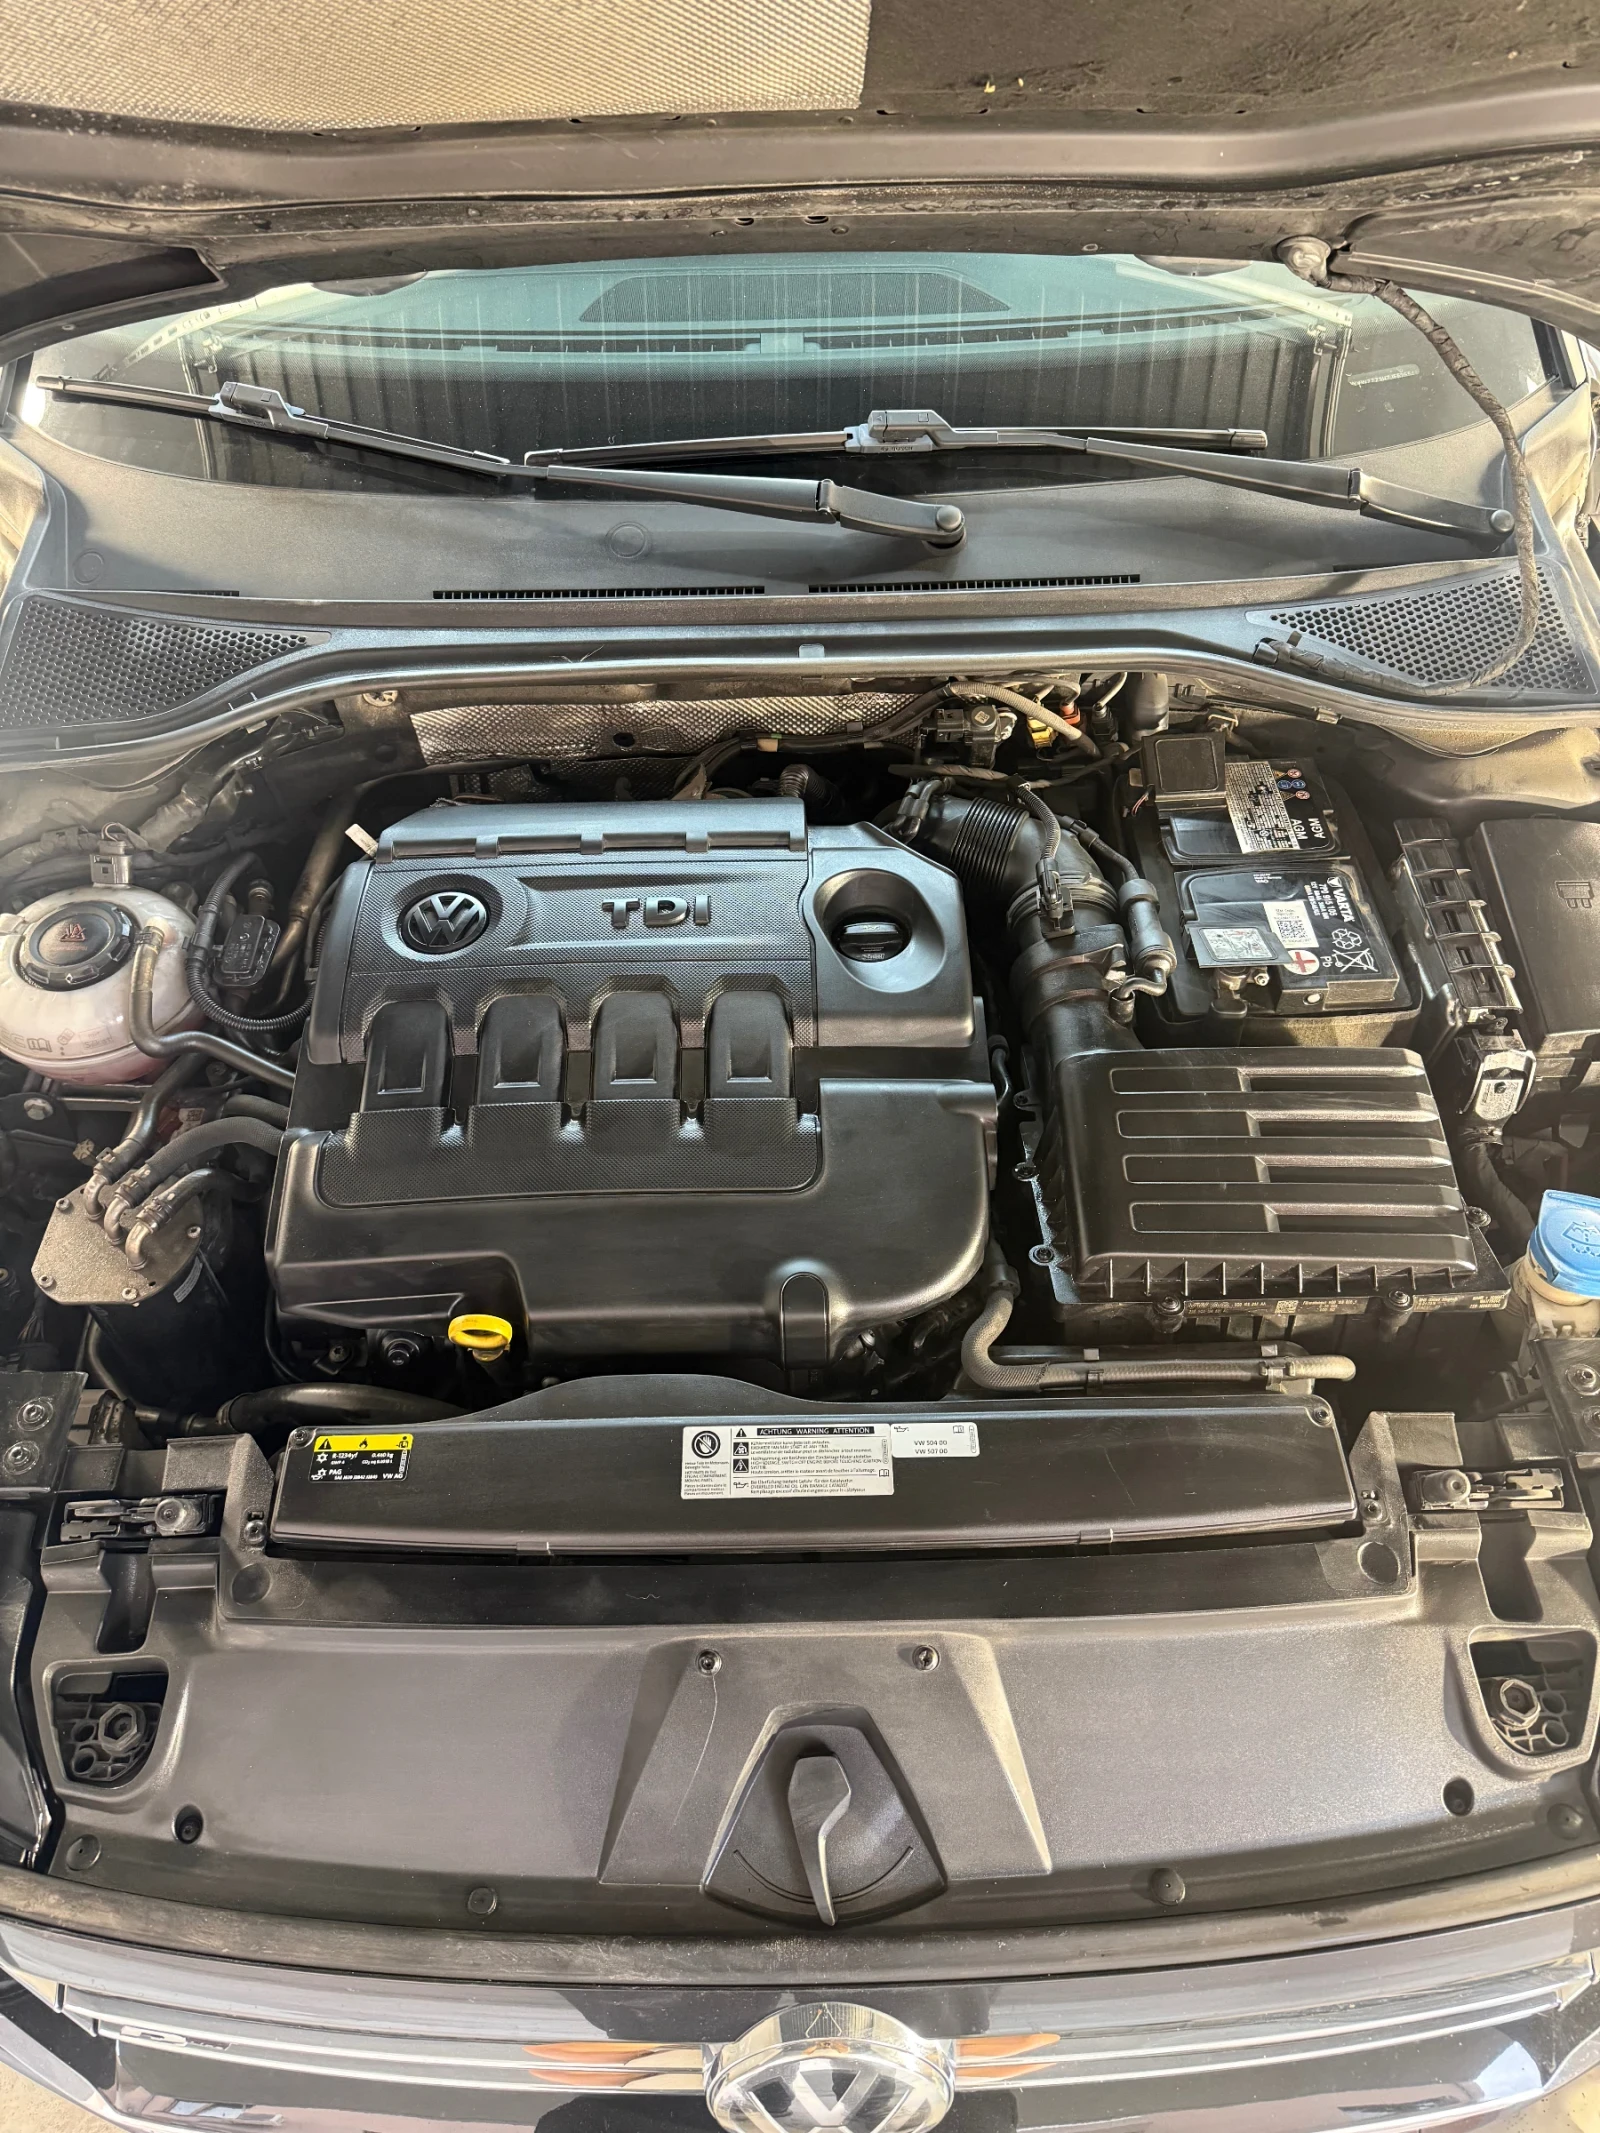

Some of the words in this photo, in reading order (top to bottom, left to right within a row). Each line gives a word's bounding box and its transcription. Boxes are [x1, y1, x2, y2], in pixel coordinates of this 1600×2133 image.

[1290, 818, 1308, 840] AGM
[1308, 817, 1326, 839] AGM
[602, 895, 711, 929] TDI
[1333, 888, 1354, 923] VARTA
[1320, 955, 1333, 968] Pb
[759, 1427, 792, 1435] ACHTUNG
[332, 1452, 359, 1460] R-1234yf
